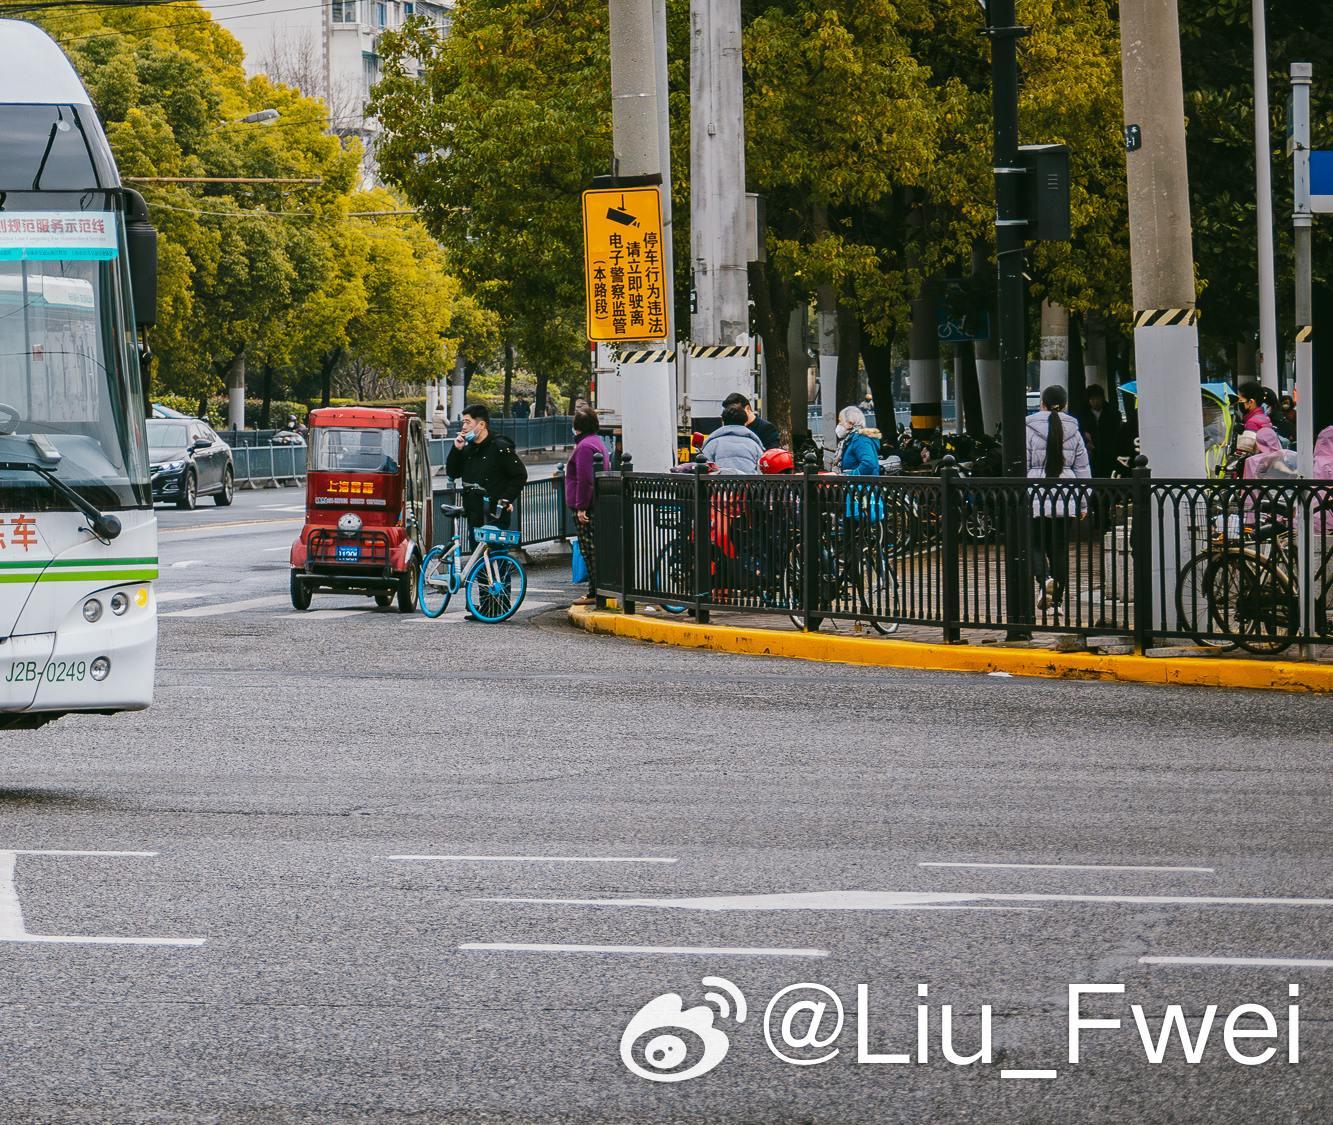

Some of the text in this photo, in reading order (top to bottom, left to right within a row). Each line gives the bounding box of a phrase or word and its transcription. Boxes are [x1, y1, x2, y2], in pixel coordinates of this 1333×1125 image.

[608, 232, 628, 335] 电子警察监管
[625, 240, 645, 327] 请立即驶离
[642, 231, 664, 334] 停车行为违法
[5, 661, 86, 683] J2B-0249
